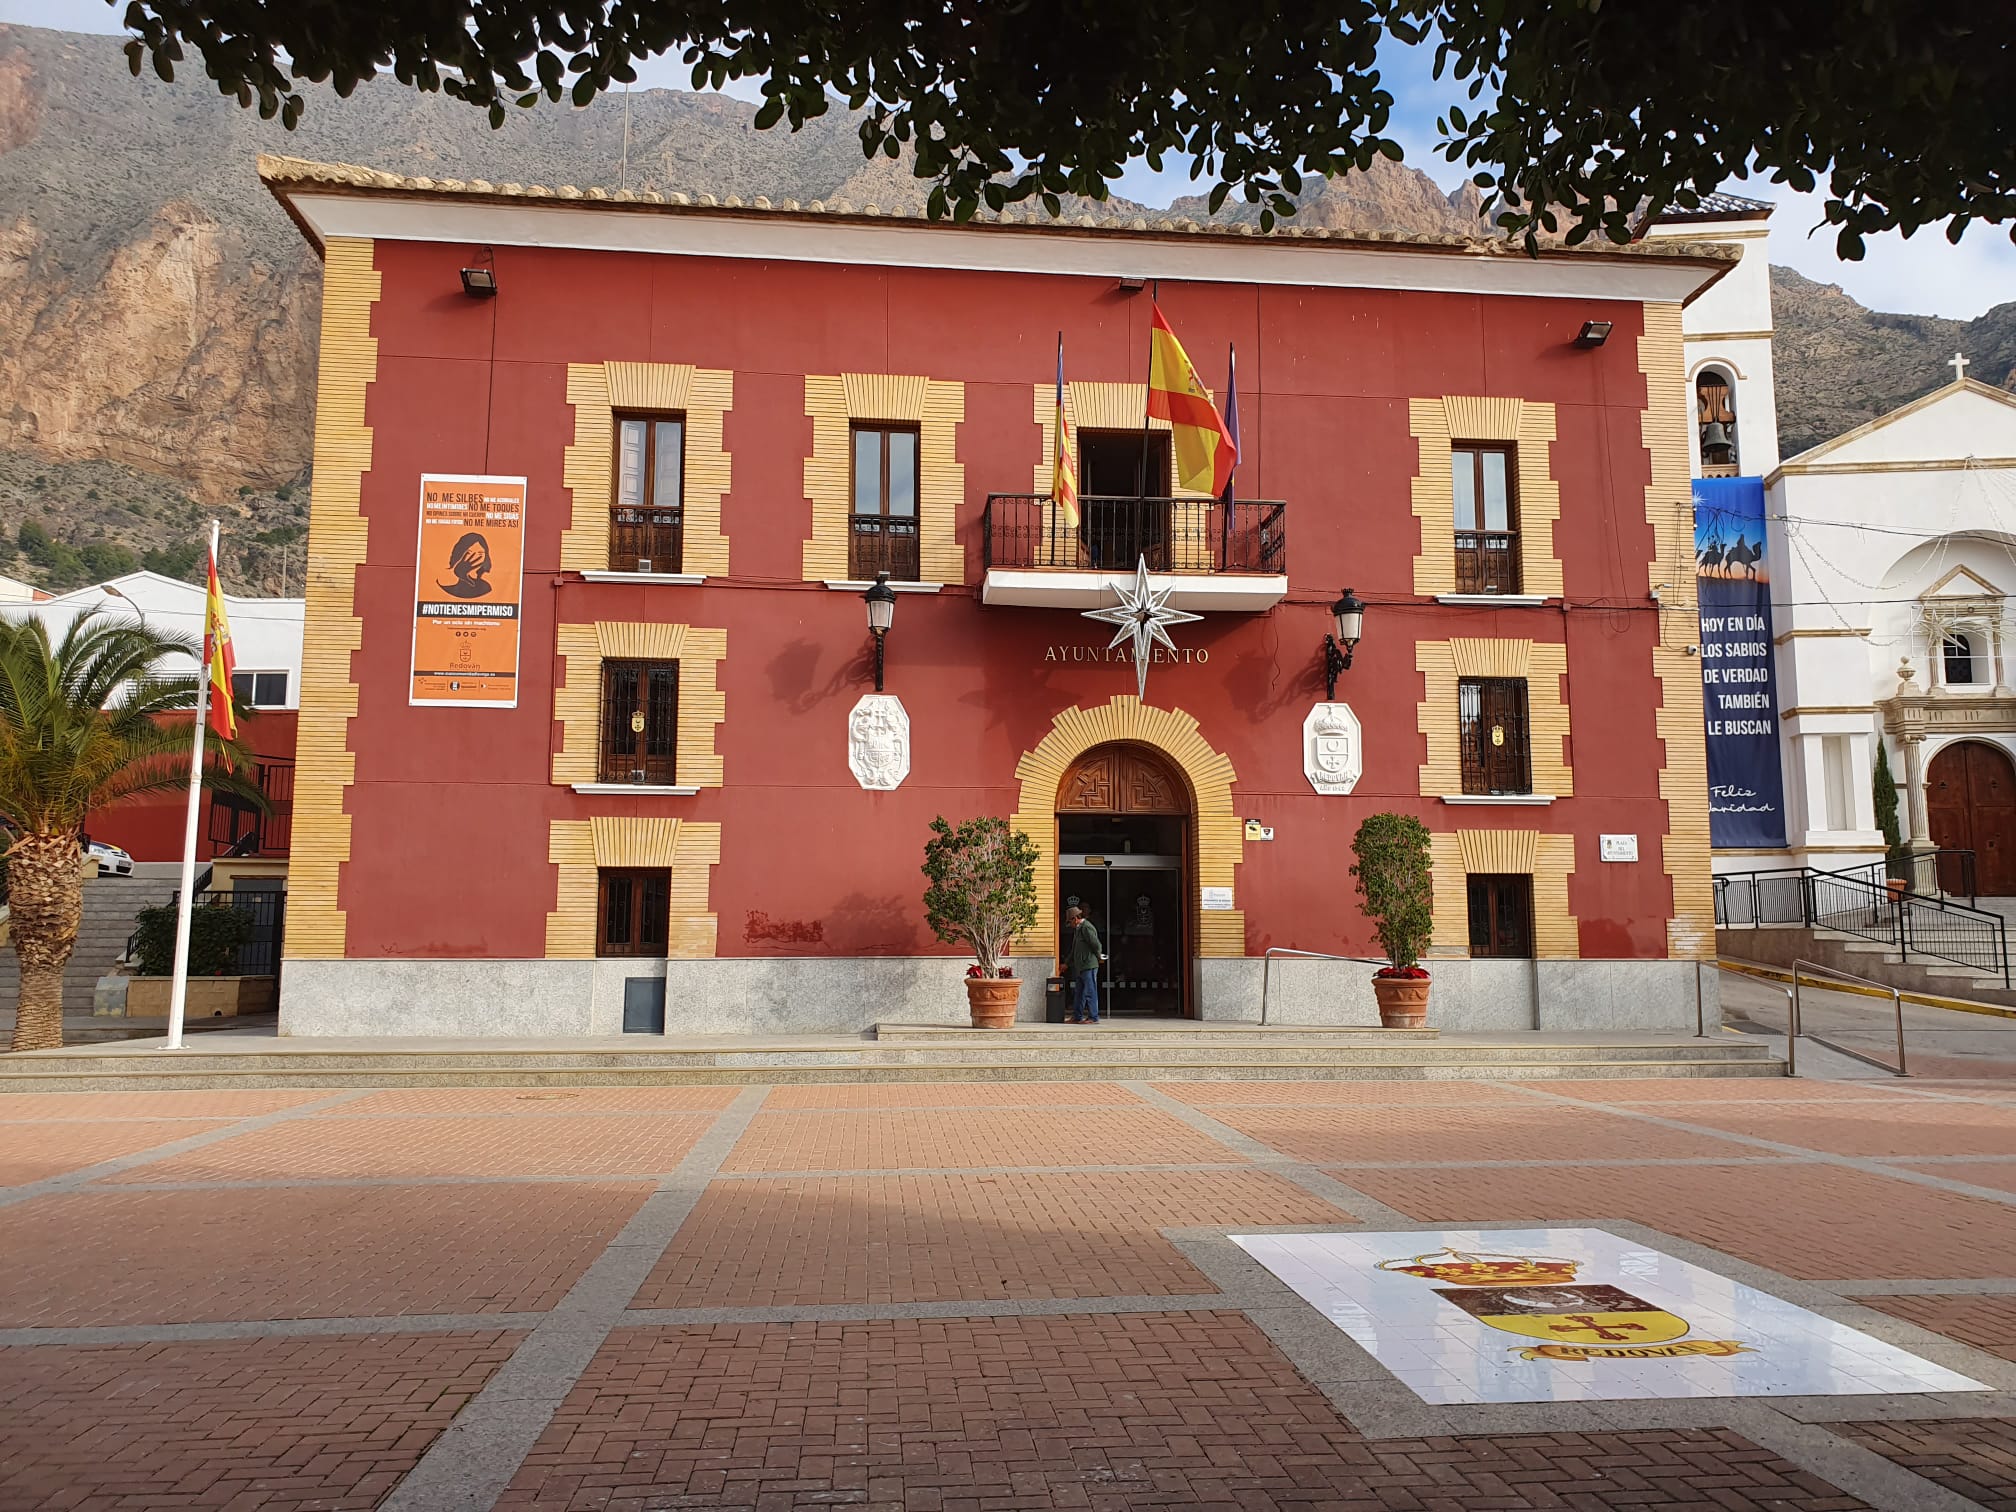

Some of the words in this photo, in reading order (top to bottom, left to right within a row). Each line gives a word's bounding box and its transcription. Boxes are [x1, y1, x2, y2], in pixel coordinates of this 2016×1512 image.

[427, 492, 438, 502] NO
[442, 493, 454, 503] ME
[456, 493, 484, 504] SILBES
[469, 503, 479, 512] NO
[480, 504, 491, 512] ME
[493, 504, 520, 513] TOQUES
[464, 519, 472, 527] NO
[474, 519, 484, 527] ME
[486, 519, 506, 528] MIRES
[422, 604, 513, 617] #NOTIENESMIPERMISO
[1701, 617, 1725, 632] HOY
[1728, 616, 1744, 632] EN
[1746, 614, 1766, 631] DÍA
[1044, 646, 1209, 664] AYUNTAENTO
[1701, 643, 1723, 658] LOS
[1725, 642, 1768, 657] SABIOS
[1703, 669, 1720, 684] DE
[1722, 668, 1768, 683] VERDAD
[1718, 691, 1770, 709] TAMBIÉN
[1707, 720, 1722, 736] LE
[1725, 719, 1772, 735] BUSCAN
[1710, 784, 1757, 798] Feliz
